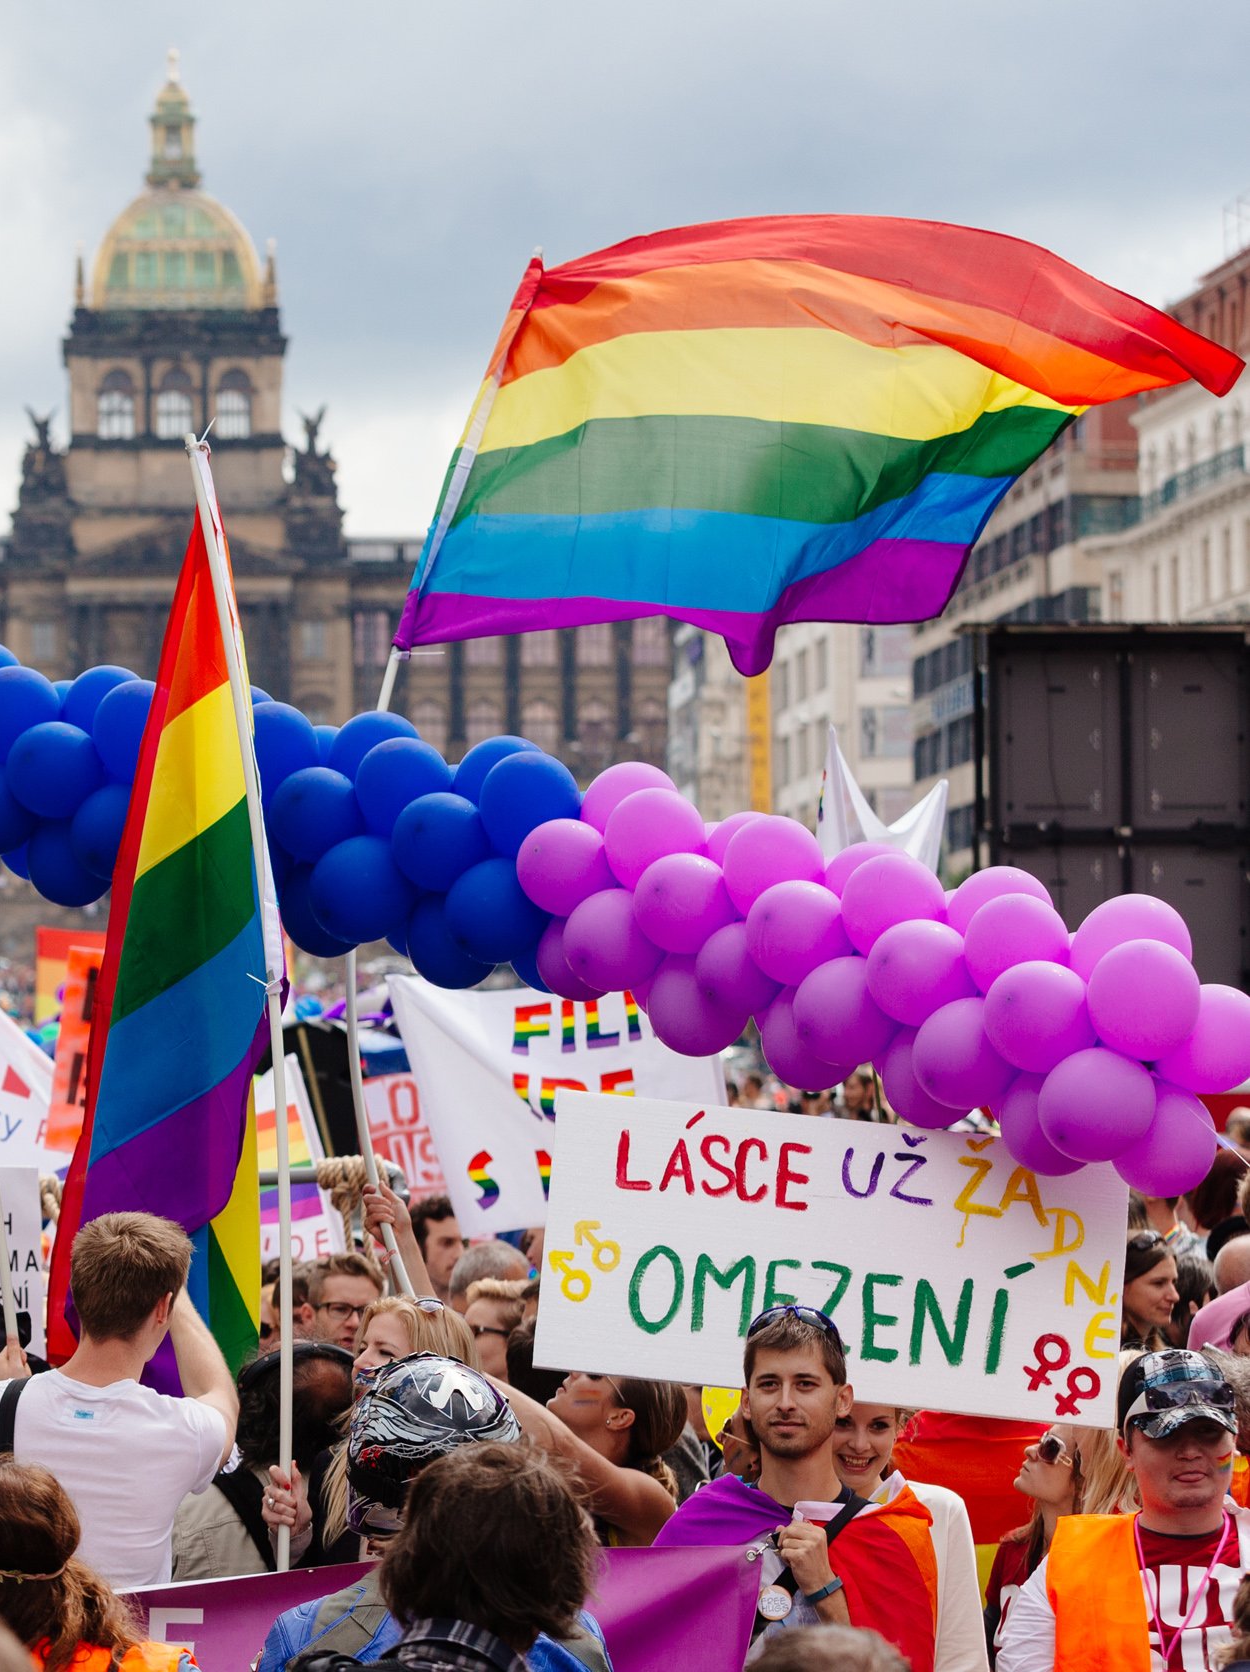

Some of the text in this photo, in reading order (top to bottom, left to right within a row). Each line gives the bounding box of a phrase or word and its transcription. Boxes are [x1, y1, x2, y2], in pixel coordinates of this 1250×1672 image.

[615, 1110, 813, 1212] LÁSCE
[841, 1132, 934, 1207] UŽ
[25, 1250, 39, 1272] A
[628, 1244, 1036, 1376] OMEZENÍ
[761, 1597, 786, 1606] FREE
[761, 1604, 789, 1613] HUGS
